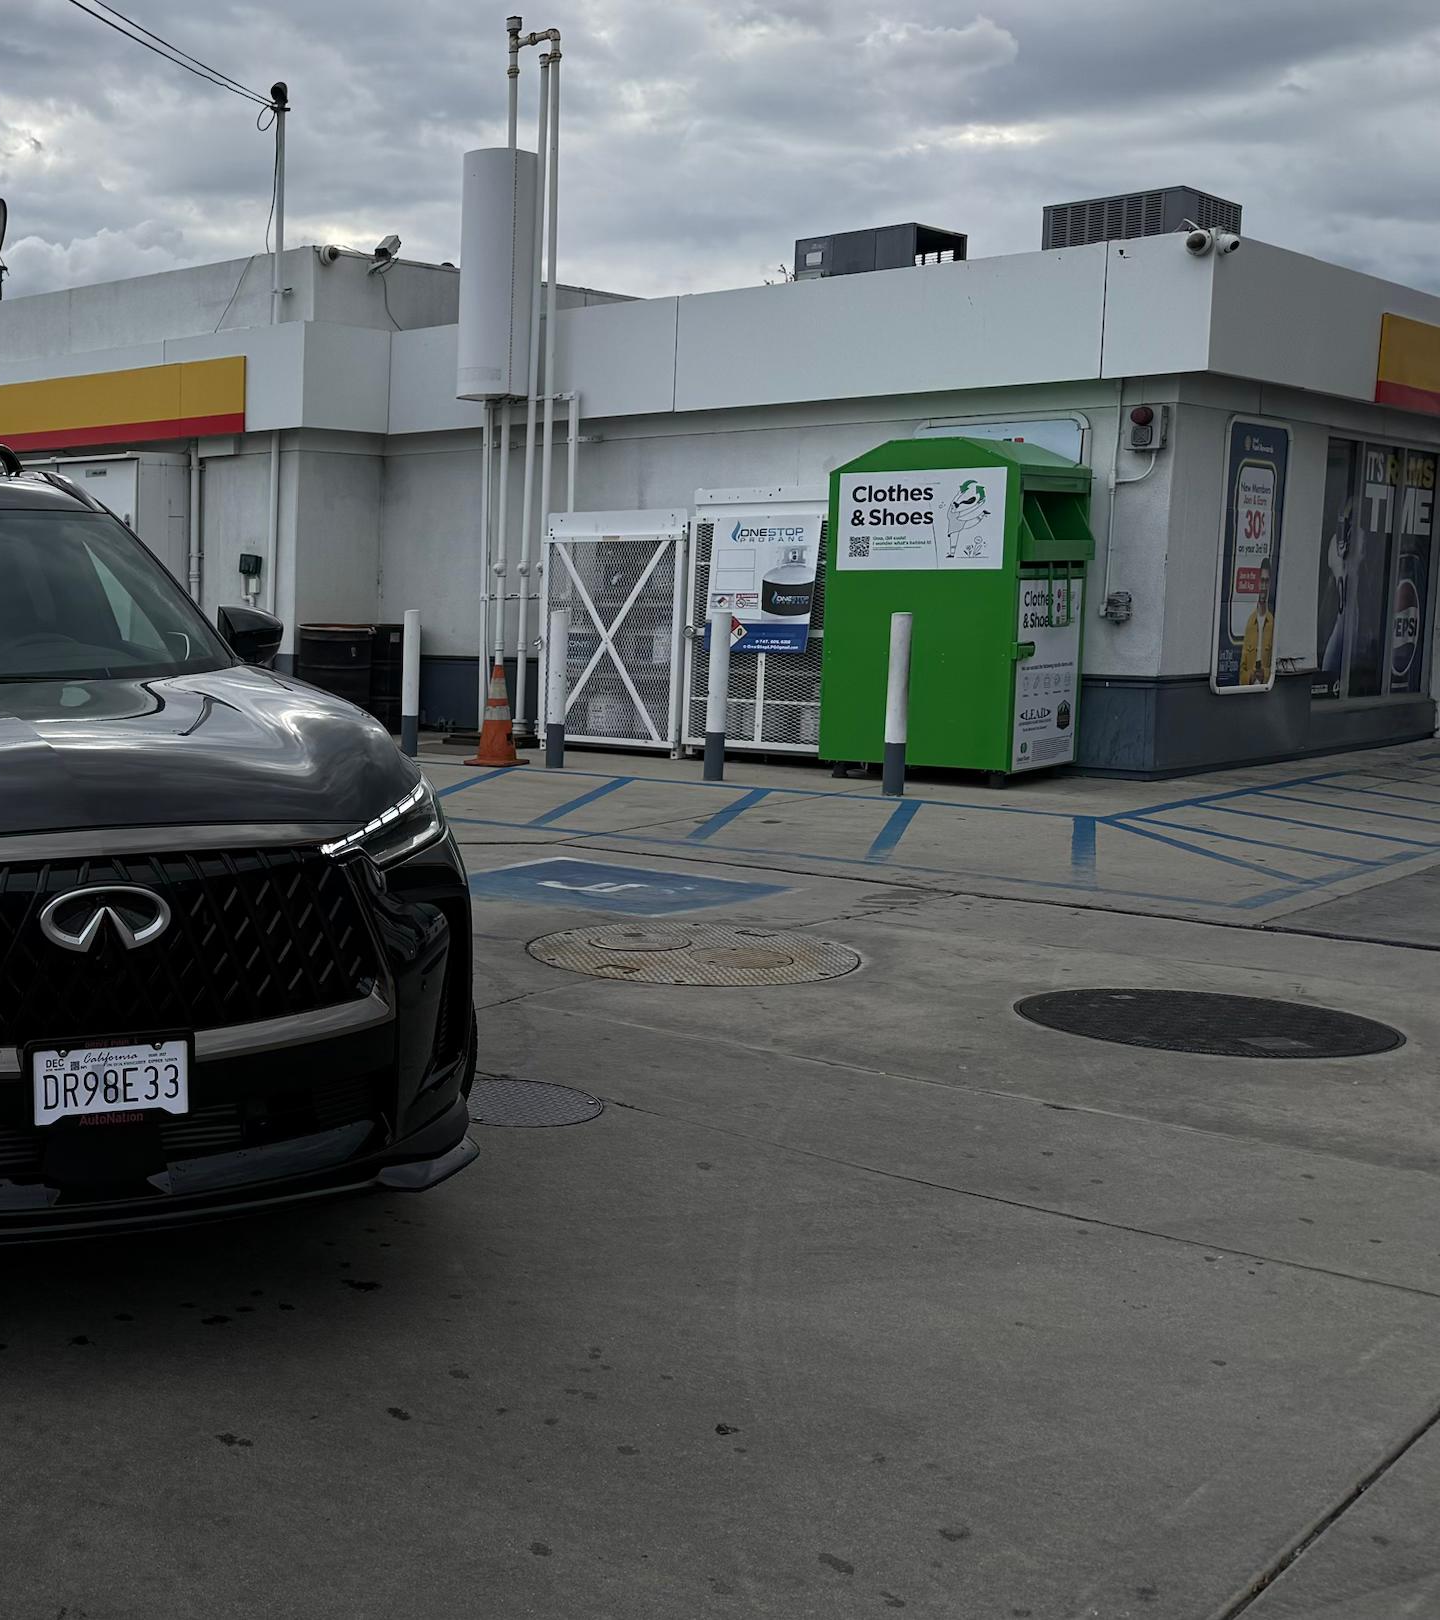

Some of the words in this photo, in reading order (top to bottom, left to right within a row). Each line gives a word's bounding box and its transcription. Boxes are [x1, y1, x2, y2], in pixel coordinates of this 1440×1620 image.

[1366, 451, 1385, 482] IT'S
[1386, 454, 1435, 488] RMS
[852, 484, 934, 503] Clothes
[1240, 481, 1251, 492] New
[850, 509, 865, 526] &
[868, 508, 934, 526] Shoes
[1023, 613, 1030, 628] &
[1030, 612, 1051, 628] Shoe
[46, 1058, 65, 1068] DEC
[83, 1051, 138, 1067] California
[42, 1064, 179, 1110] DR98E33
[79, 1112, 144, 1126] AutoNation
